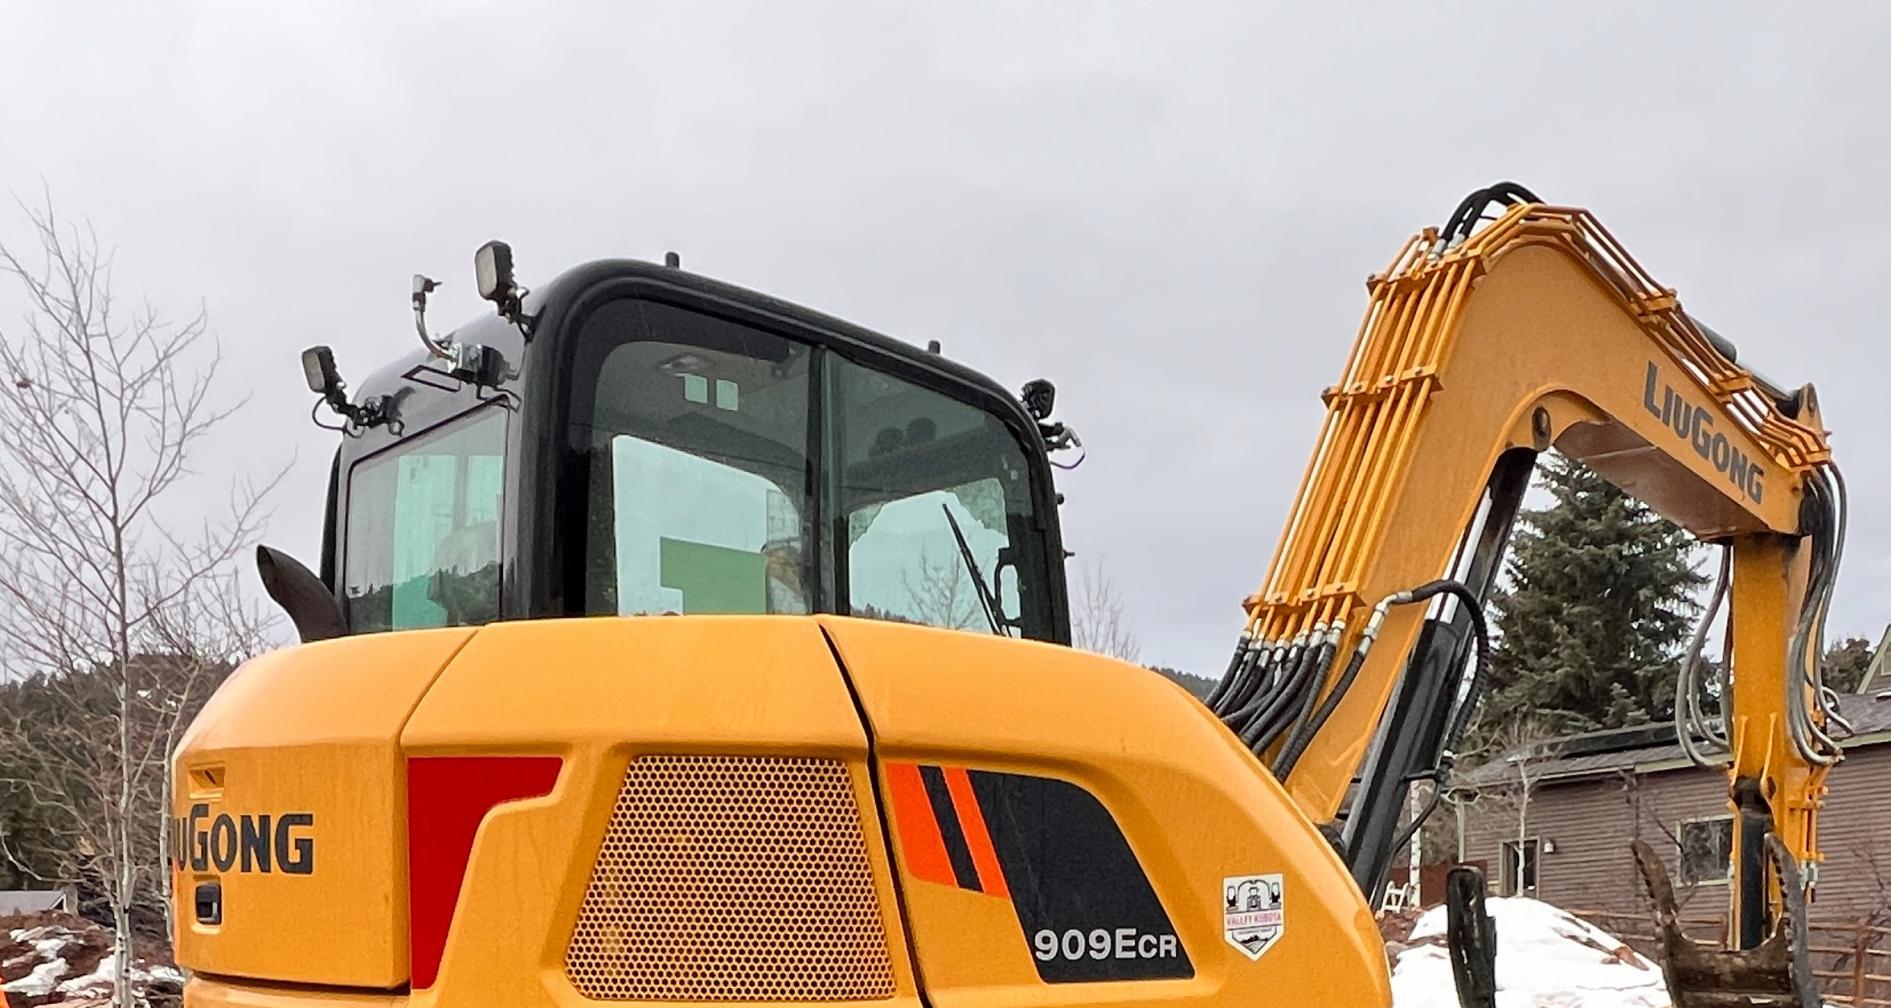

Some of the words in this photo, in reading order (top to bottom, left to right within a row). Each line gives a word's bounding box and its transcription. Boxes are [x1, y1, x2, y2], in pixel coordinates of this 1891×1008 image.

[1644, 360, 1764, 504] LIUGONG
[173, 803, 313, 875] UGONG
[1034, 928, 1177, 960] 909ECR
